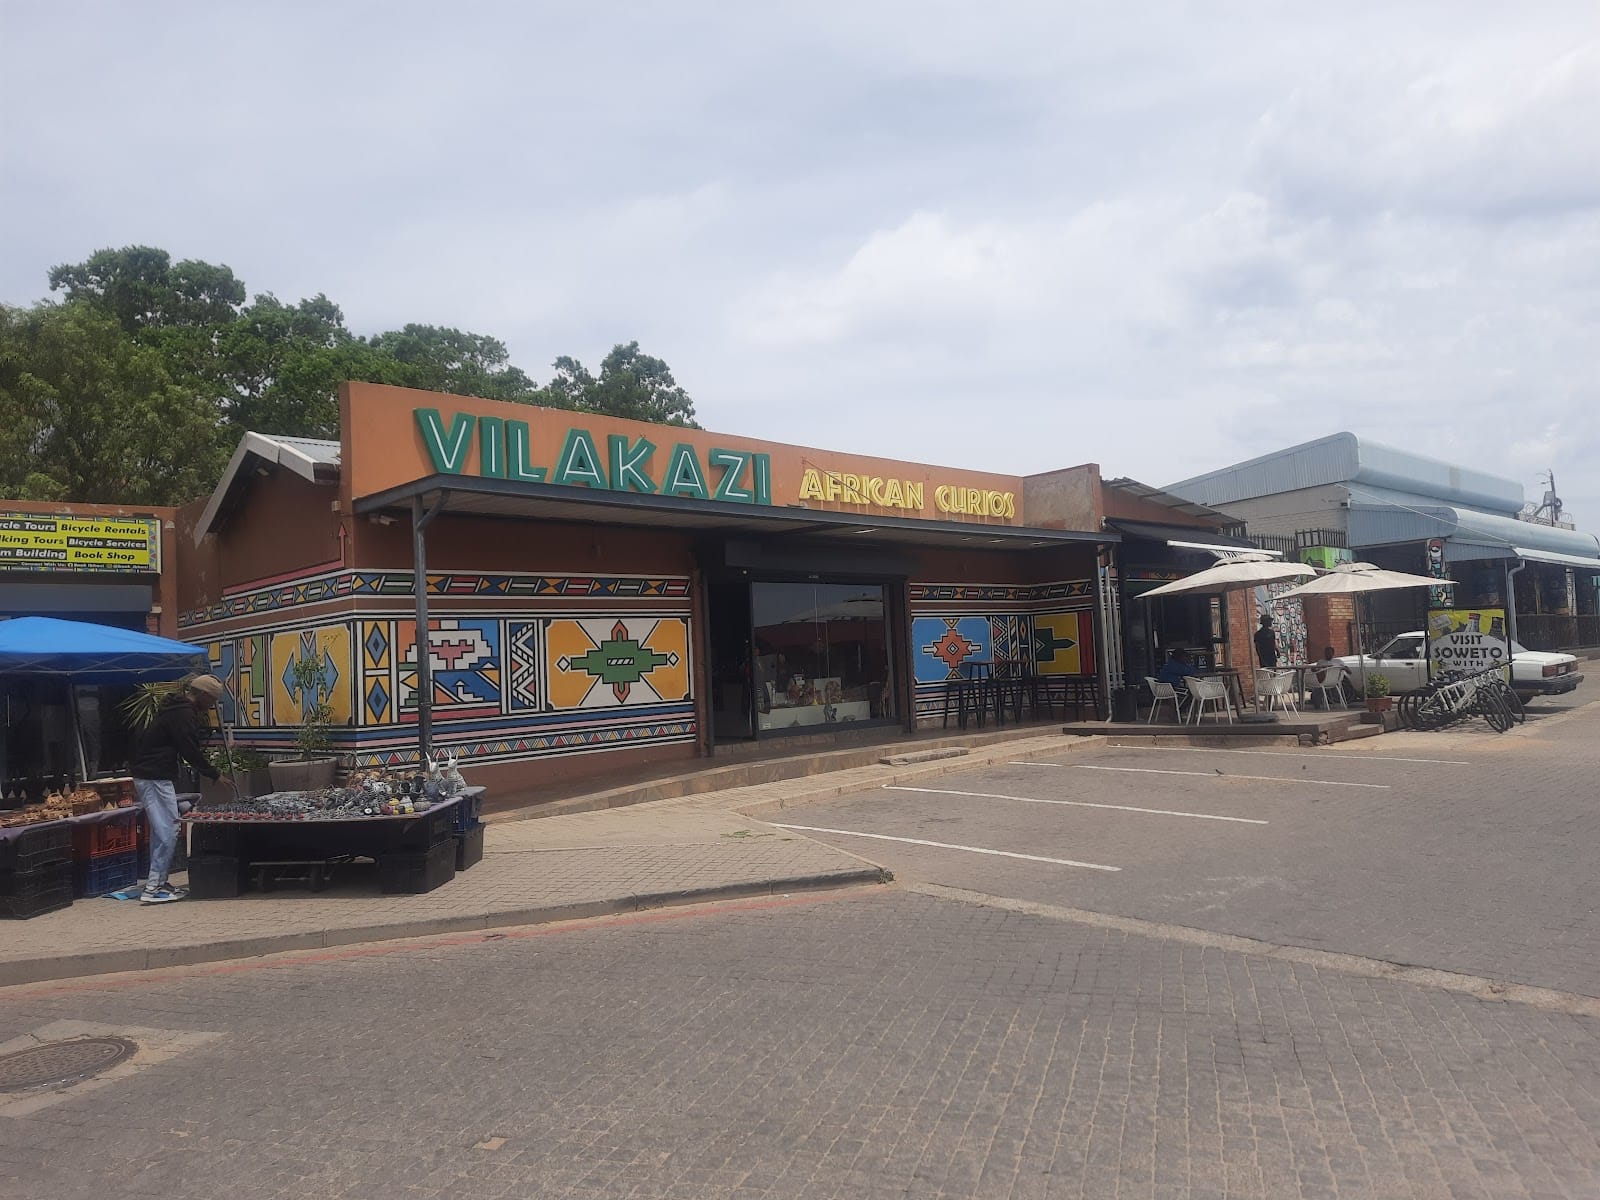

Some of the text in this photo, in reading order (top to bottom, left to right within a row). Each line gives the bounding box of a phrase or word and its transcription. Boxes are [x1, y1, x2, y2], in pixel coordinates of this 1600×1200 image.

[413, 407, 771, 505] VILAKAZI
[799, 468, 1016, 520] AFRICAN CURIOS
[24, 521, 57, 531] Tours
[61, 523, 147, 535] Bicycle Rentals
[33, 535, 65, 545] Tours
[69, 537, 147, 548] Bicycle Services
[15, 548, 67, 560] Building
[74, 550, 136, 562] Book Shop
[1450, 634, 1483, 645] VISIT
[1434, 647, 1503, 659] SOWETO
